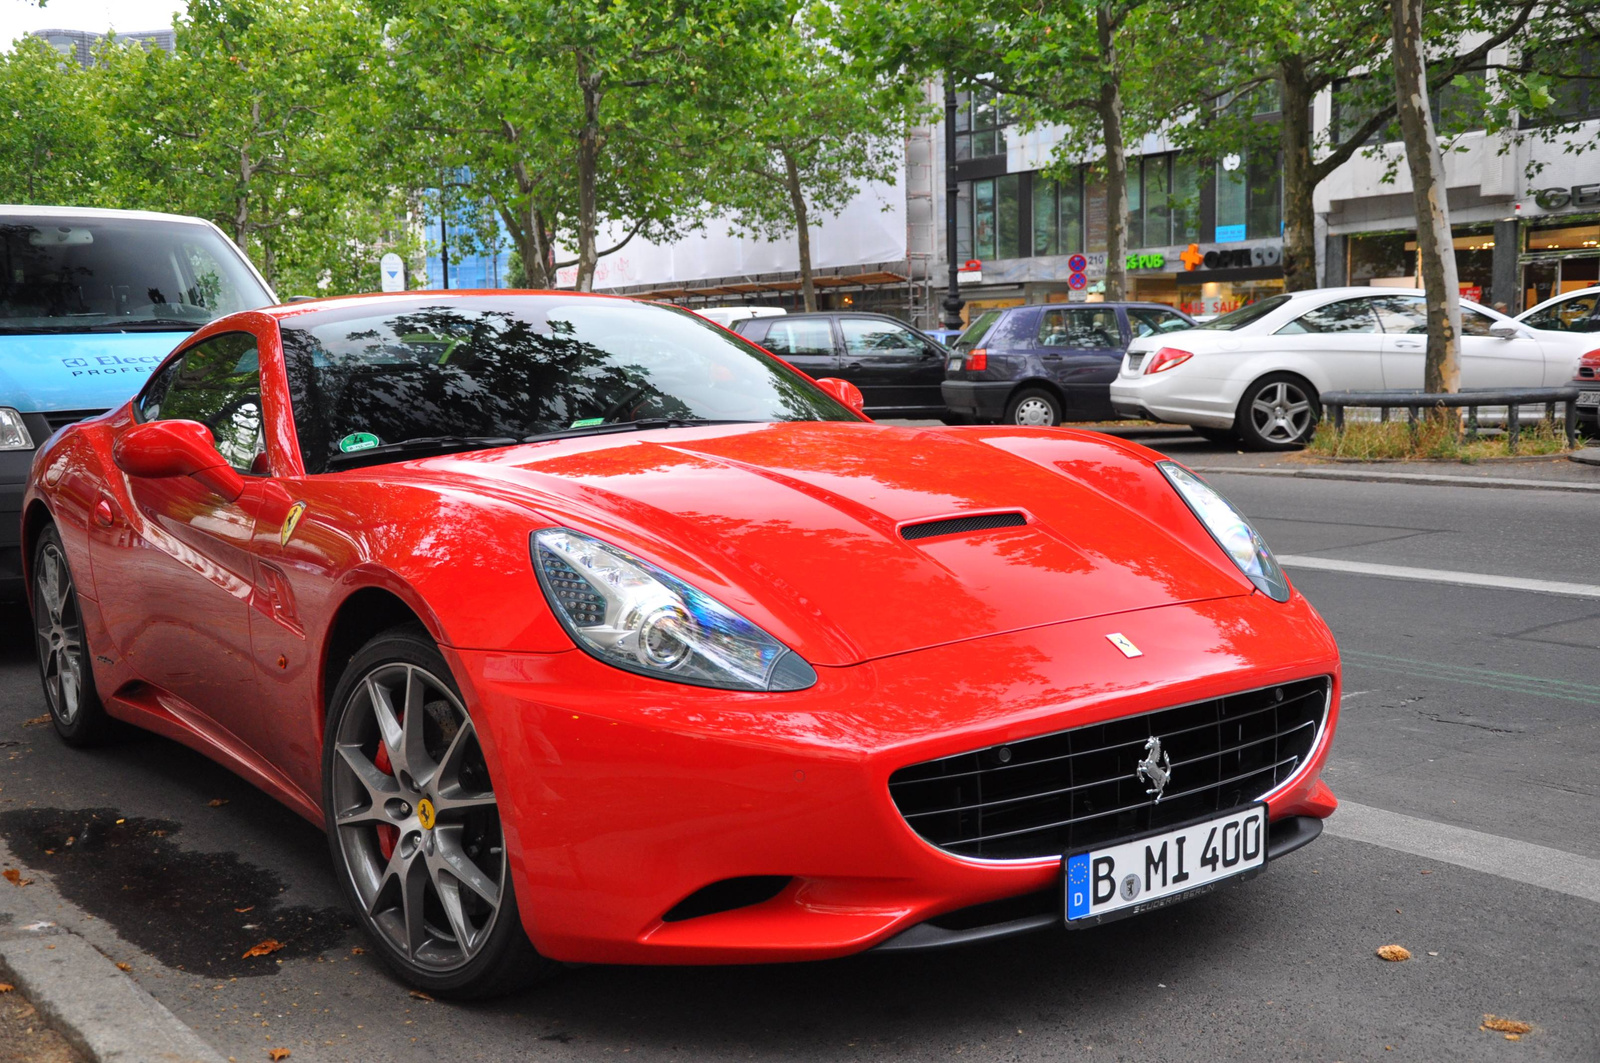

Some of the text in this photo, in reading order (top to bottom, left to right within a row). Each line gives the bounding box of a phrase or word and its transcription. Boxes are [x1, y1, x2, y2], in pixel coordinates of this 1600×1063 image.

[1088, 255, 1104, 265] 210
[1180, 302, 1205, 314] SALE
[1212, 300, 1240, 313] SALE
[1092, 814, 1261, 907] B MI 400
[1074, 892, 1083, 907] D
[1133, 883, 1215, 914] SCUDERIA BERLIN
